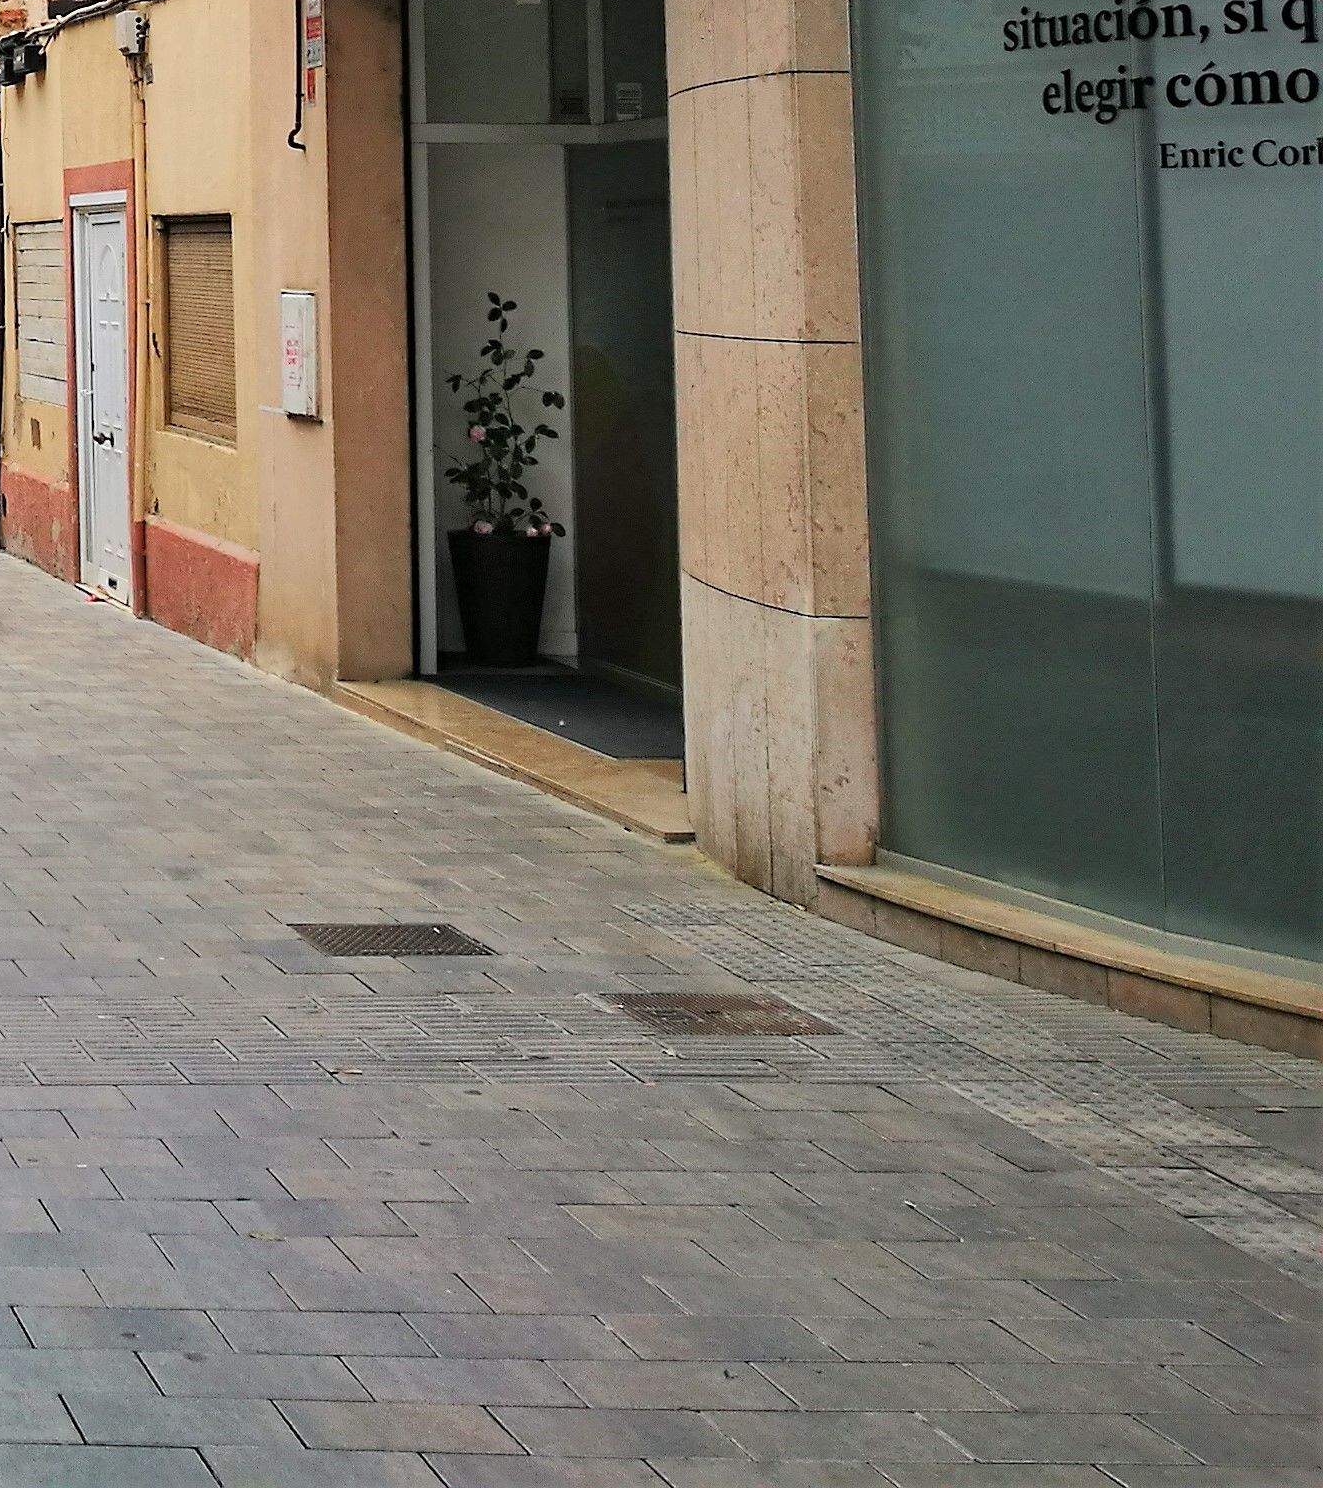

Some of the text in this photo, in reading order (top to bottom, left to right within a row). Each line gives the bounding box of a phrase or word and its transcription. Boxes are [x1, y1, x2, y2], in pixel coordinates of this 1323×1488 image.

[1042, 62, 1320, 125] elegir cómo
[1159, 140, 1245, 170] Enric
